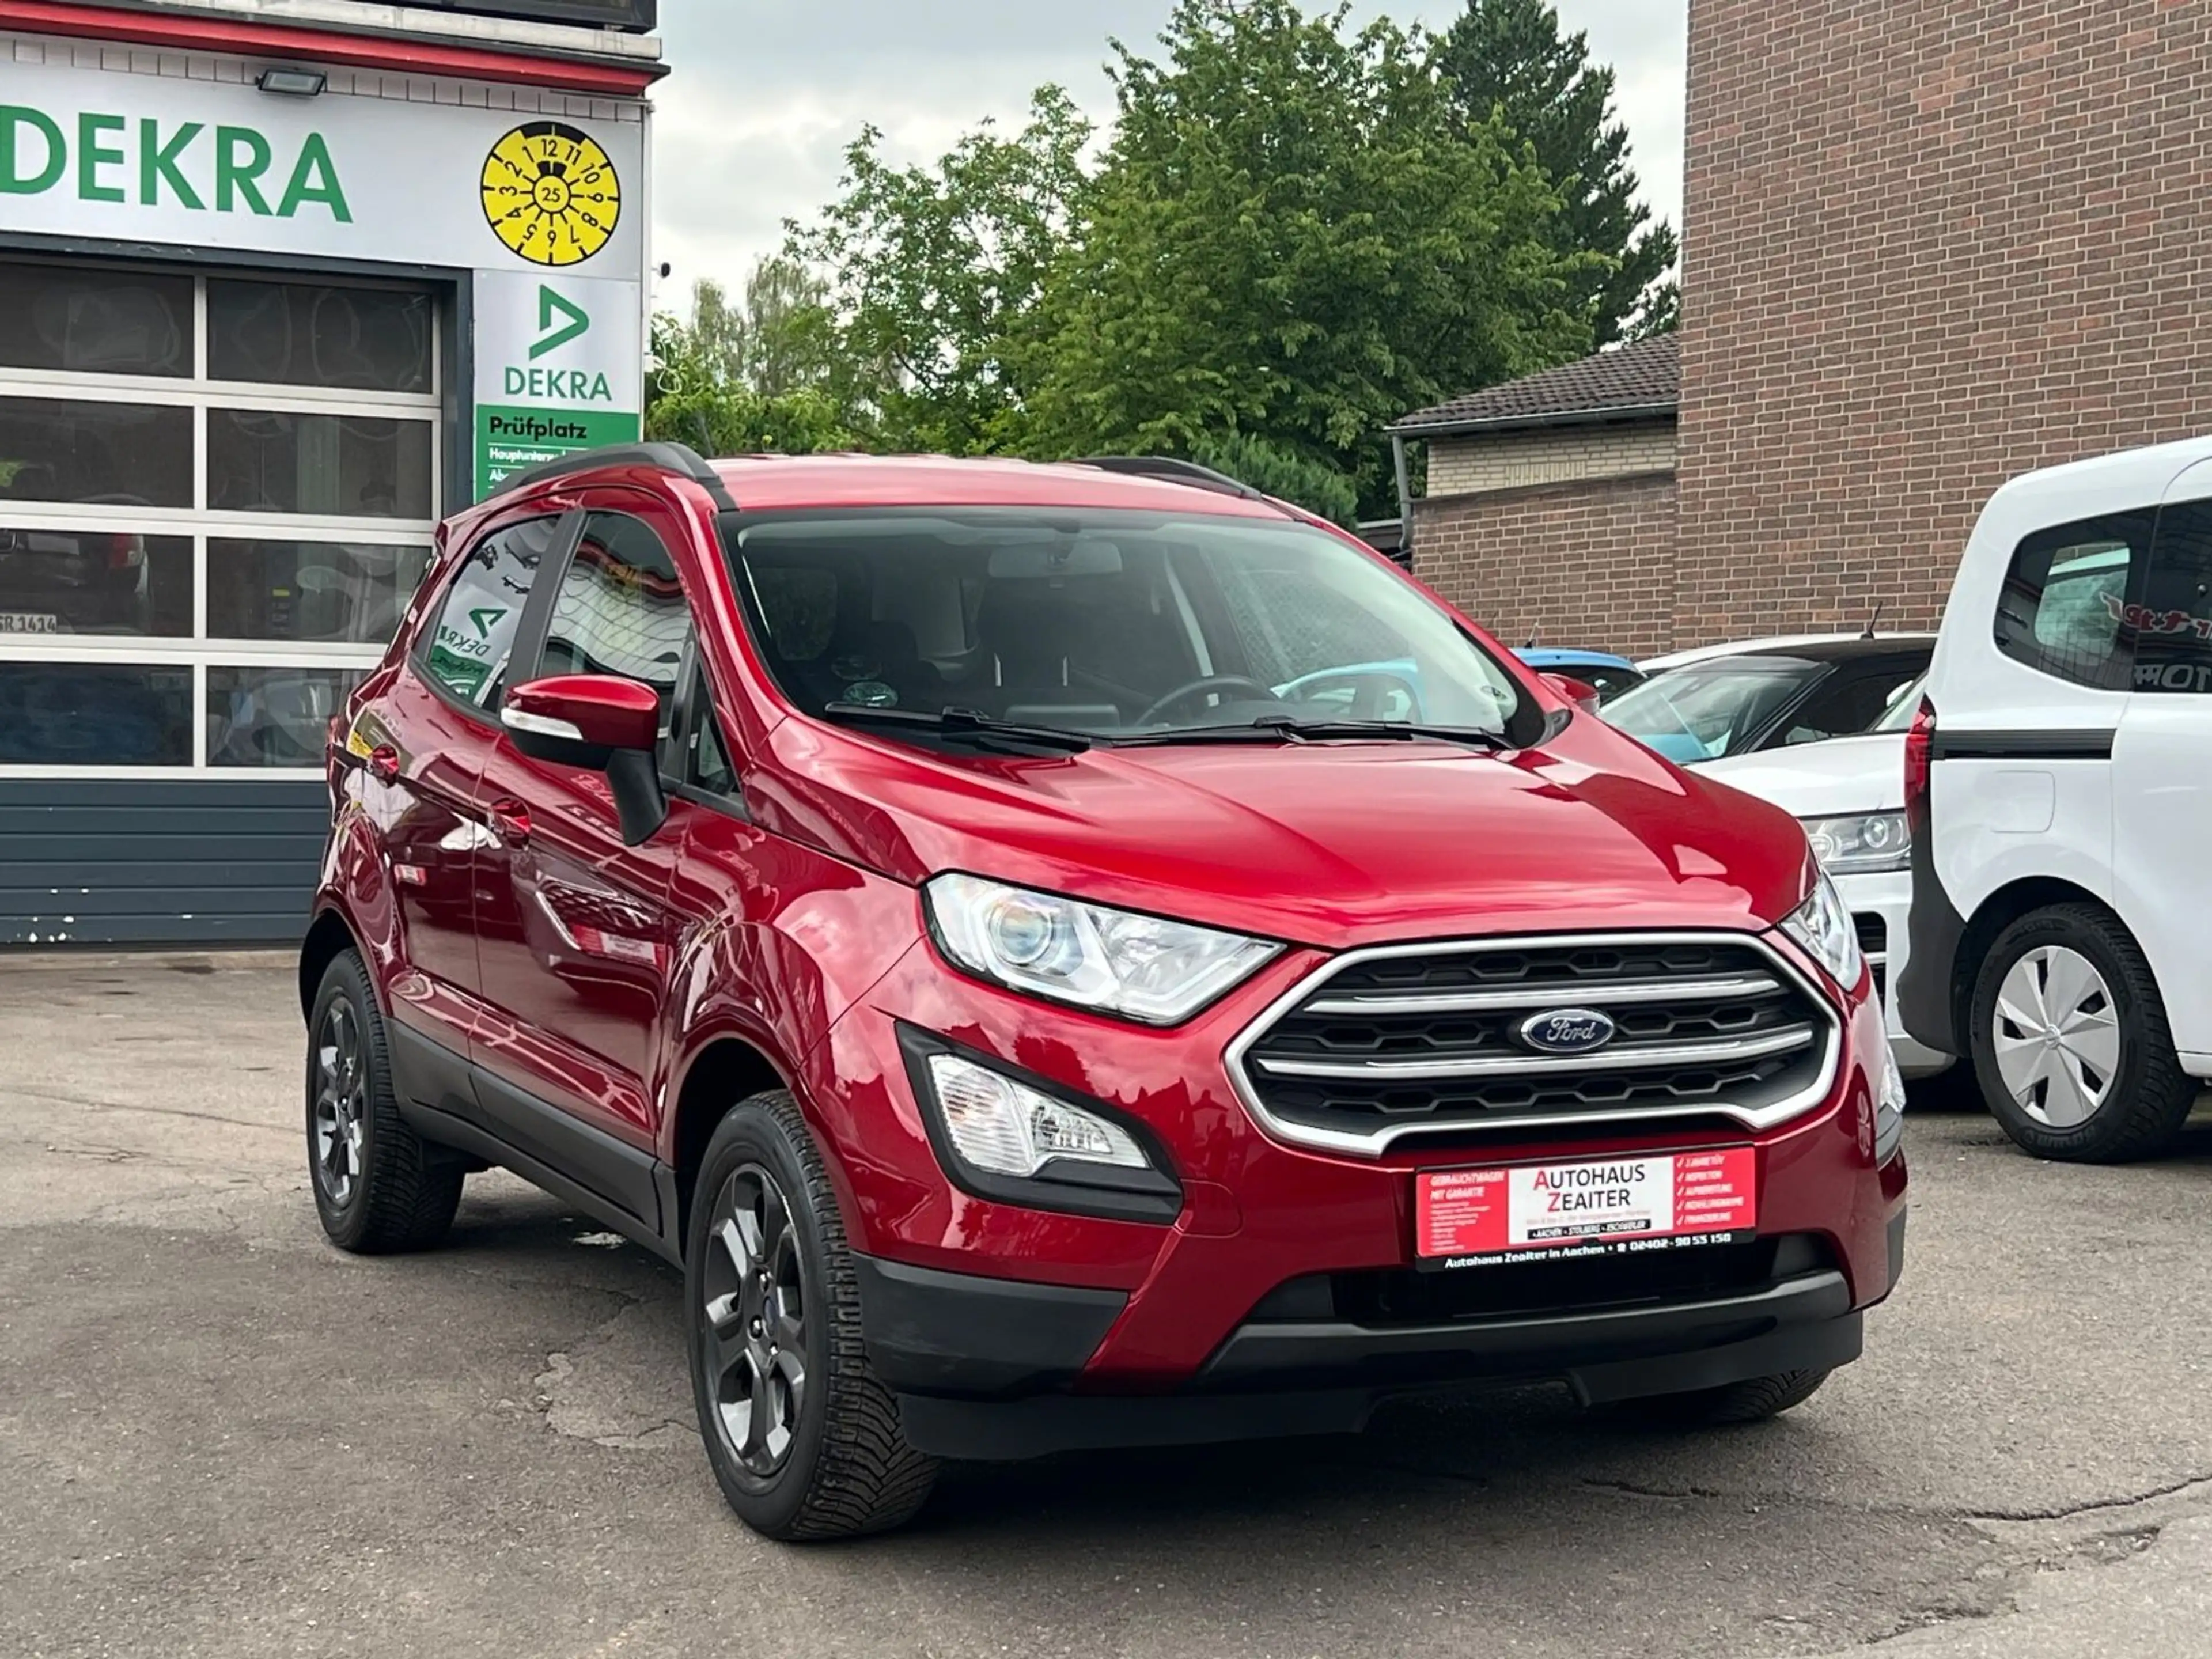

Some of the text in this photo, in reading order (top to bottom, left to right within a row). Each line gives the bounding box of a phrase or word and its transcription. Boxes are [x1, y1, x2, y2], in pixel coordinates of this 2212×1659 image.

[522, 146, 534, 162] 1
[541, 139, 558, 156] 12
[565, 145, 582, 165] 11
[0, 105, 353, 223] DEKRA
[504, 161, 522, 177] 2
[580, 163, 601, 184] 10
[499, 186, 518, 196] 3
[541, 187, 560, 202] 25
[586, 192, 604, 203] 9
[506, 207, 522, 217] 4
[581, 213, 598, 226] 8
[522, 224, 537, 241] 5
[548, 230, 556, 248] 6
[570, 225, 580, 244] 7
[505, 366, 612, 402] DEKRA
[489, 416, 588, 441] Prüfplatz
[1546, 1017, 1596, 1041] Ford
[1533, 1164, 1645, 1190] AUTOHAUS
[1547, 1189, 1630, 1212] ZEAITER
[1445, 1255, 1502, 1268] Autohaus
[1562, 1245, 1605, 1257] Aachen
[1630, 1238, 1668, 1251] 02402
